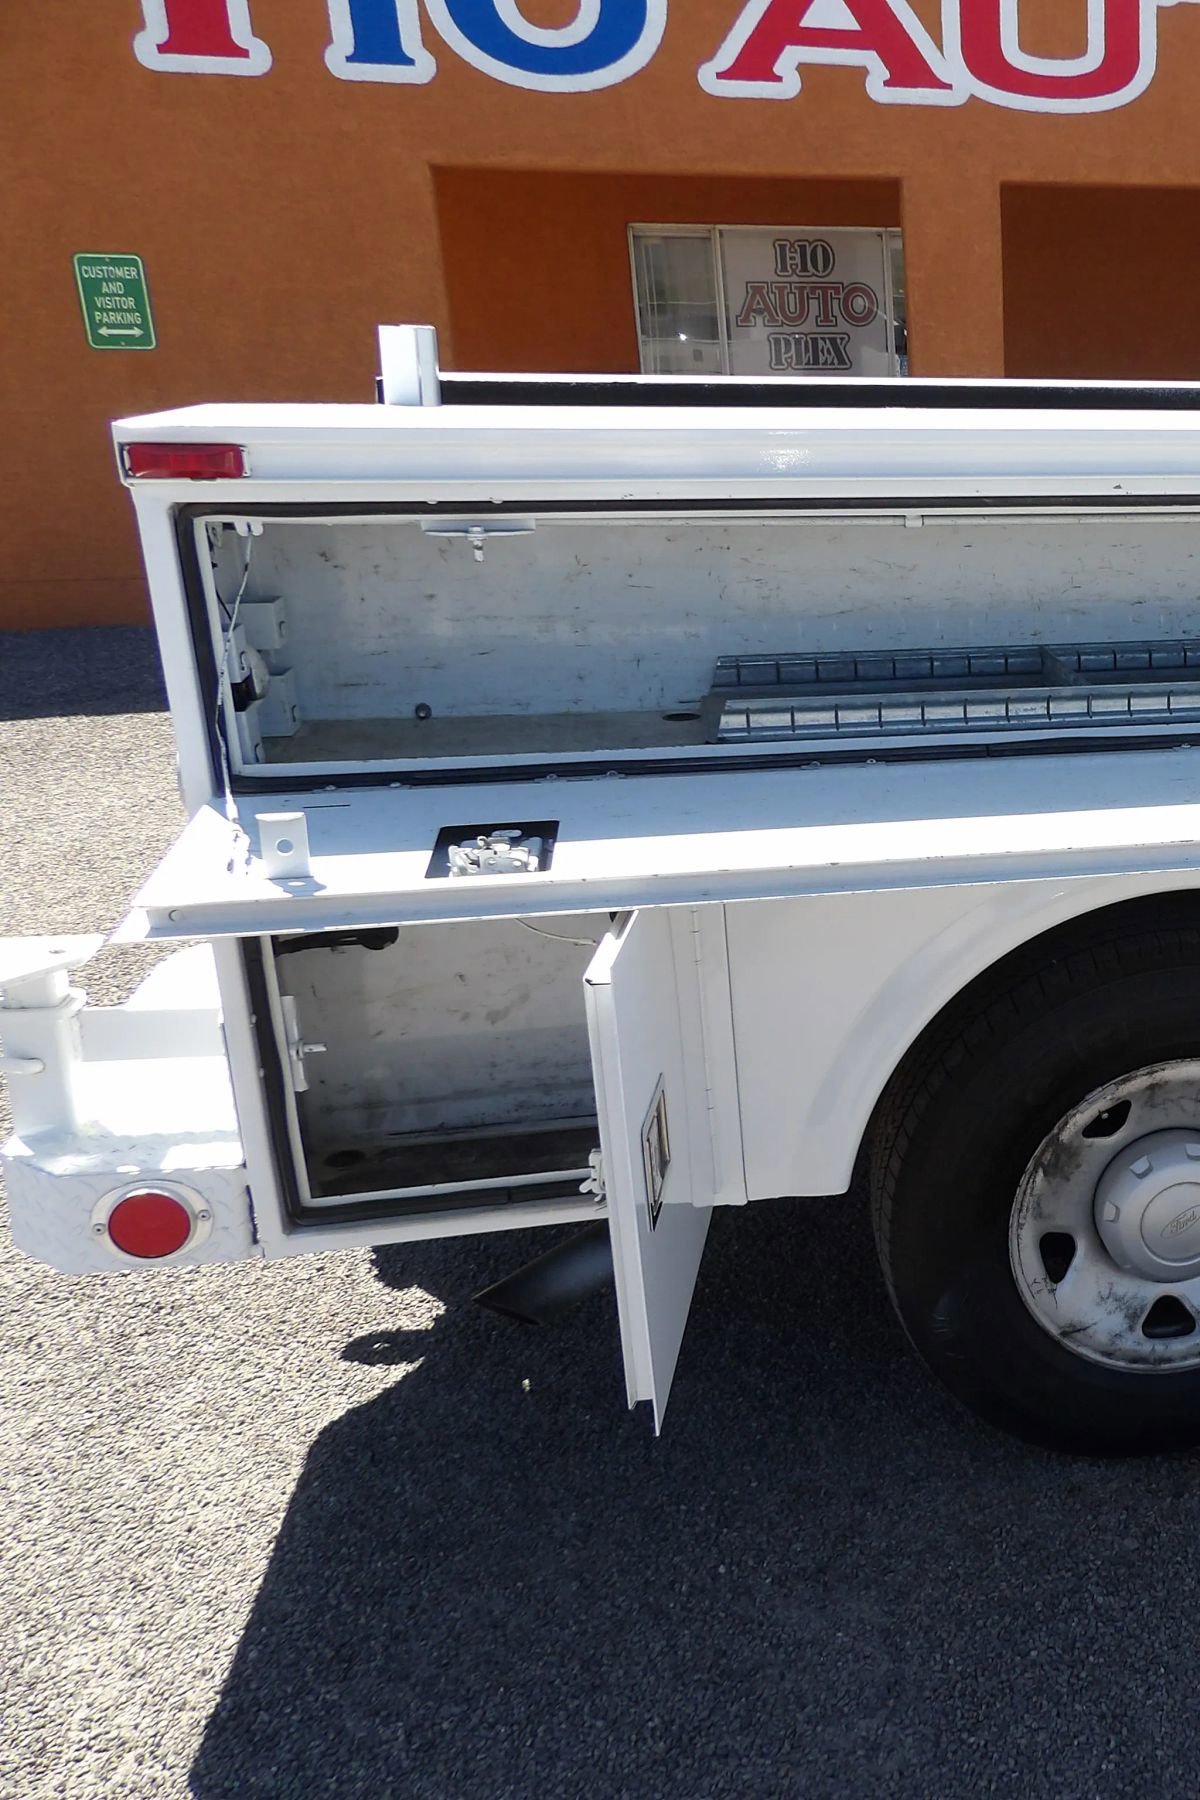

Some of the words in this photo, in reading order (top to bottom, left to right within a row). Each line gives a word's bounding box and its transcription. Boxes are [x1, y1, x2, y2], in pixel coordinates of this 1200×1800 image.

[81, 265, 139, 279] CUSTOMER
[101, 281, 125, 294] AND
[94, 296, 136, 309] VISITOR
[736, 281, 878, 327] AUTO
[94, 311, 142, 324] PARKING
[768, 332, 852, 371] PLEX
